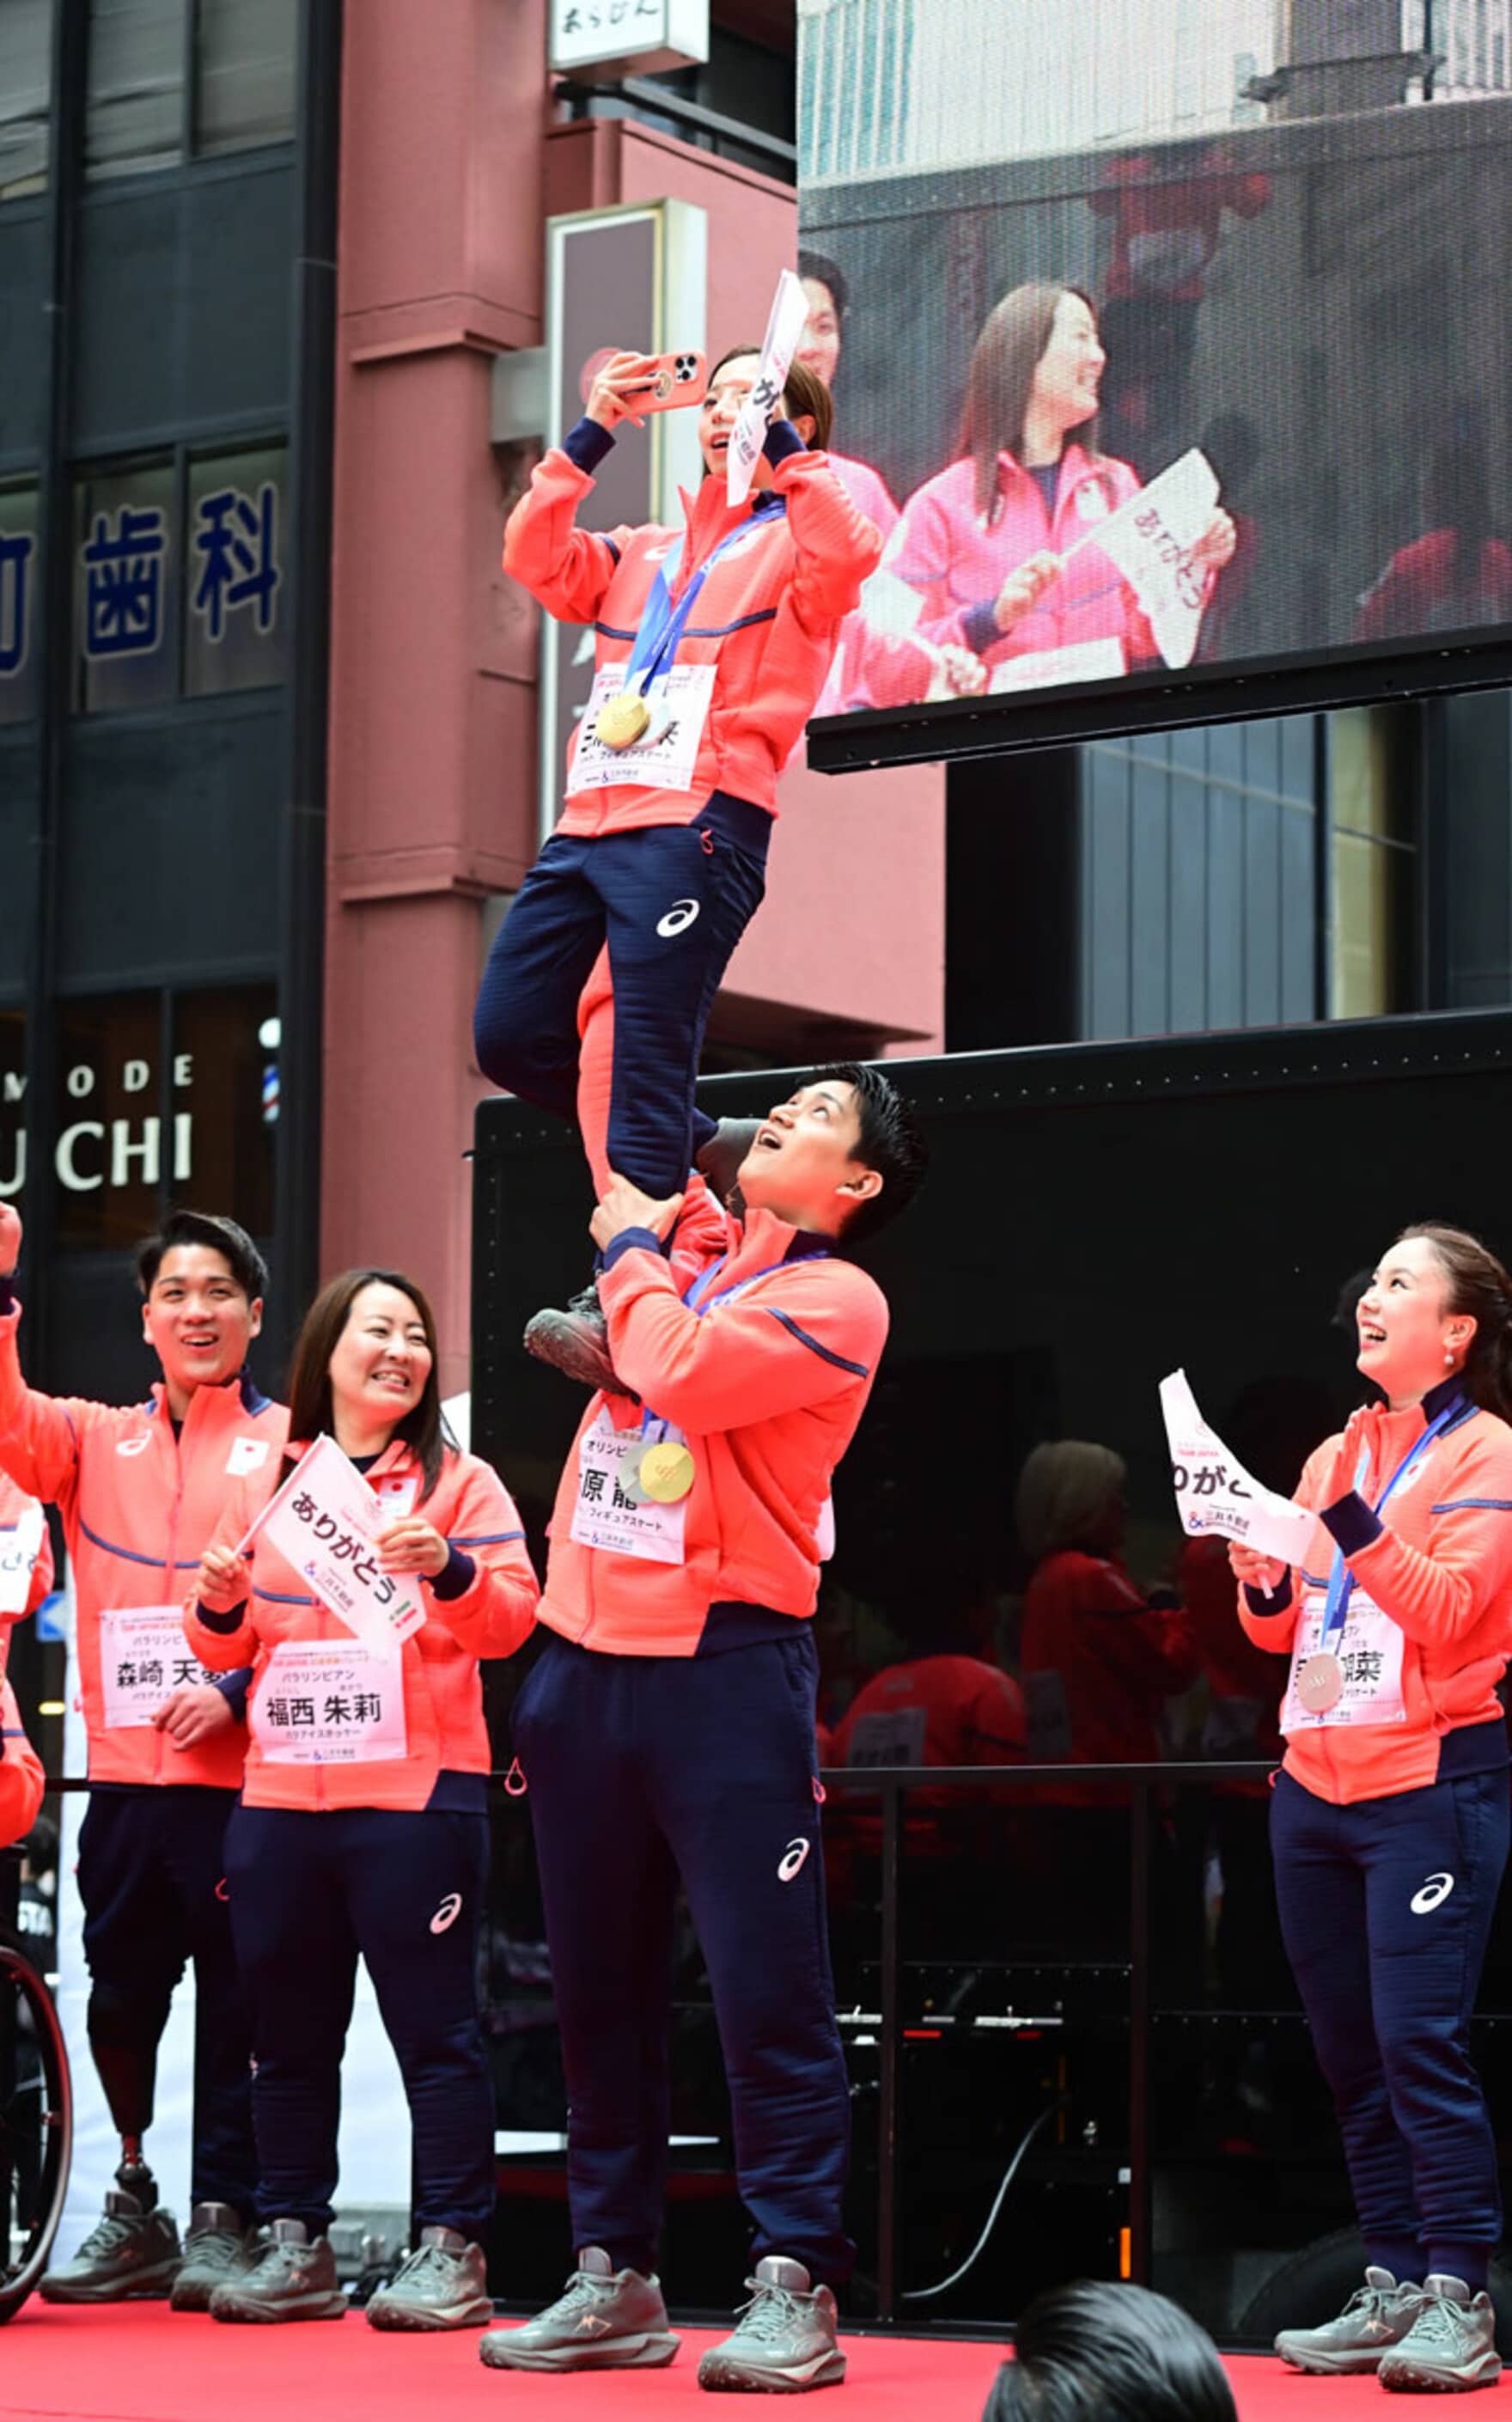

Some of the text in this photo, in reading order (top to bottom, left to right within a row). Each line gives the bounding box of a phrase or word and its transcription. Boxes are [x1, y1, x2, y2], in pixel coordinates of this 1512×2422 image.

[117, 1659, 164, 1690] 森崎
[266, 1692, 381, 1727] 福西 朱莉
